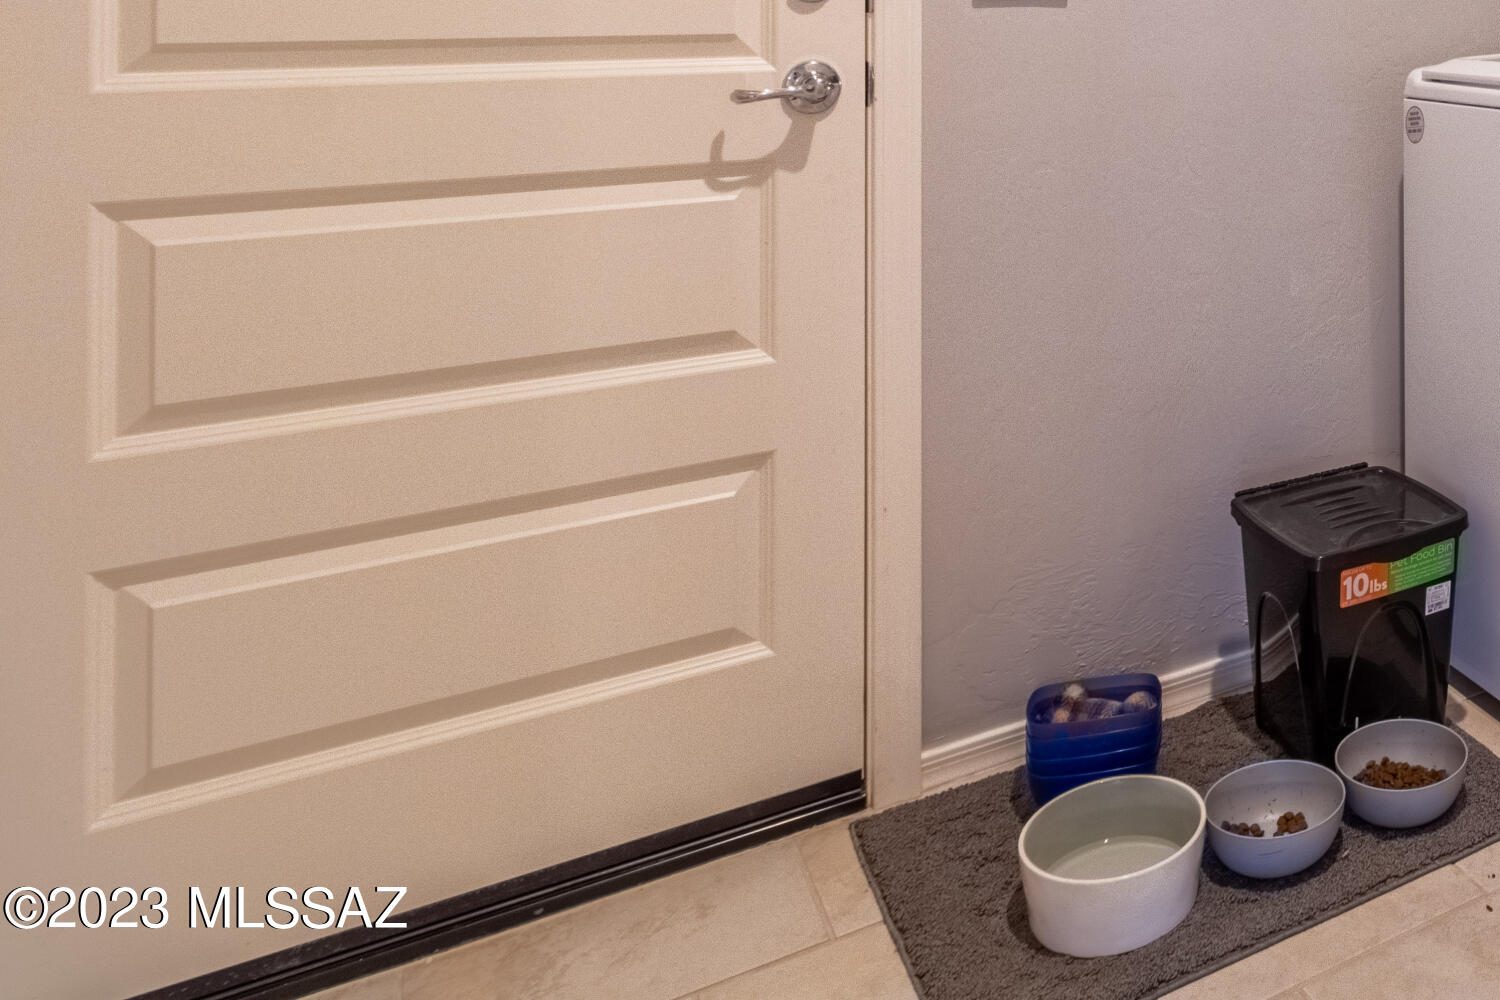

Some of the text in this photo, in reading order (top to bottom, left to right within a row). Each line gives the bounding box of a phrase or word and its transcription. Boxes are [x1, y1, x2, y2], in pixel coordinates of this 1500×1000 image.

[1410, 548, 1436, 563] Food
[1437, 542, 1454, 555] Bin
[1343, 572, 1369, 601] 10
[1369, 579, 1388, 594] lbs
